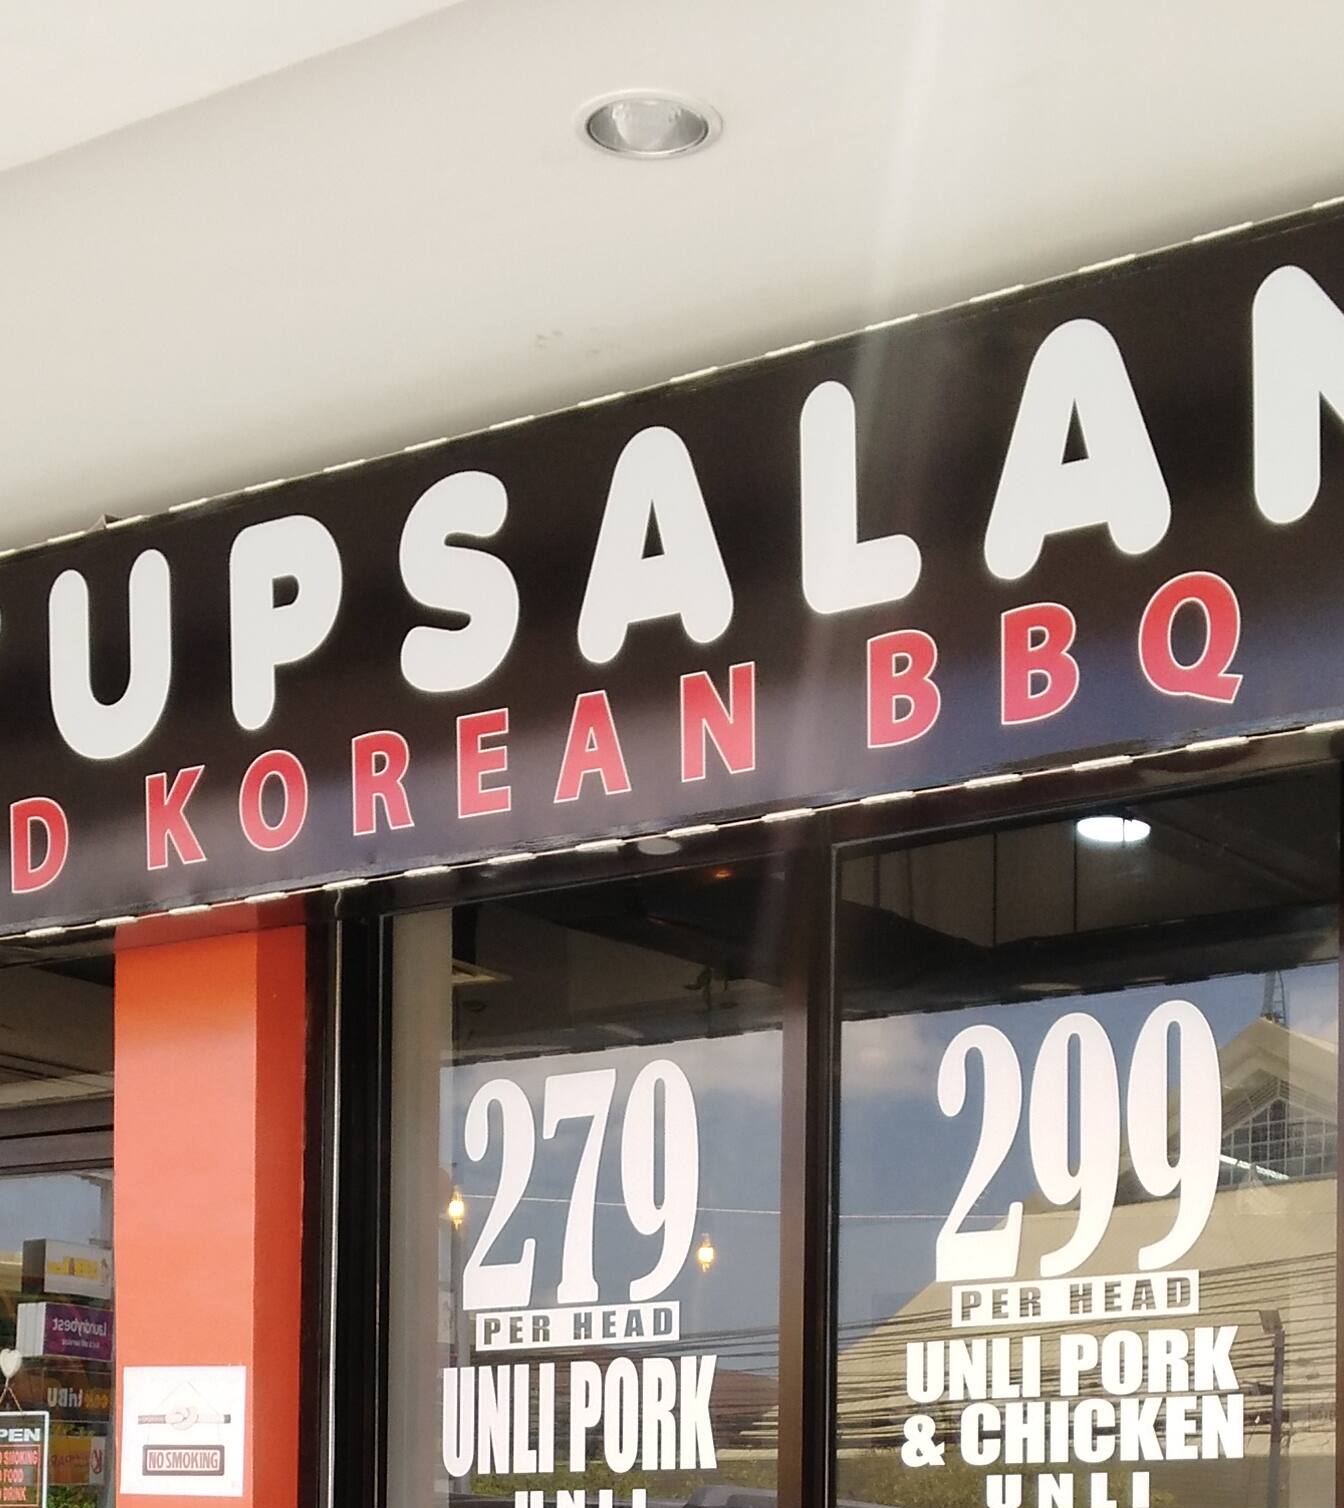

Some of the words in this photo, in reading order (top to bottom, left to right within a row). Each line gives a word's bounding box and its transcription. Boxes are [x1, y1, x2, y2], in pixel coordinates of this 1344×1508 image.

[145, 661, 755, 870] KOREAN
[867, 571, 1244, 748] BBQ
[936, 1000, 1222, 1282] 299
[463, 1060, 699, 1310] 279
[483, 1312, 551, 1346] PER
[573, 1306, 674, 1341] HEAD
[960, 1285, 1042, 1322] PER
[1069, 1276, 1192, 1315] HEAD
[906, 1335, 1041, 1403] UNLI
[1060, 1326, 1238, 1396] PORK
[443, 1363, 554, 1476] UNLI
[570, 1355, 716, 1473] PORK
[901, 1414, 945, 1467] &
[960, 1394, 1244, 1466] CHICKEN
[148, 1451, 164, 1469] NO
[165, 1451, 218, 1469] SMOKING
